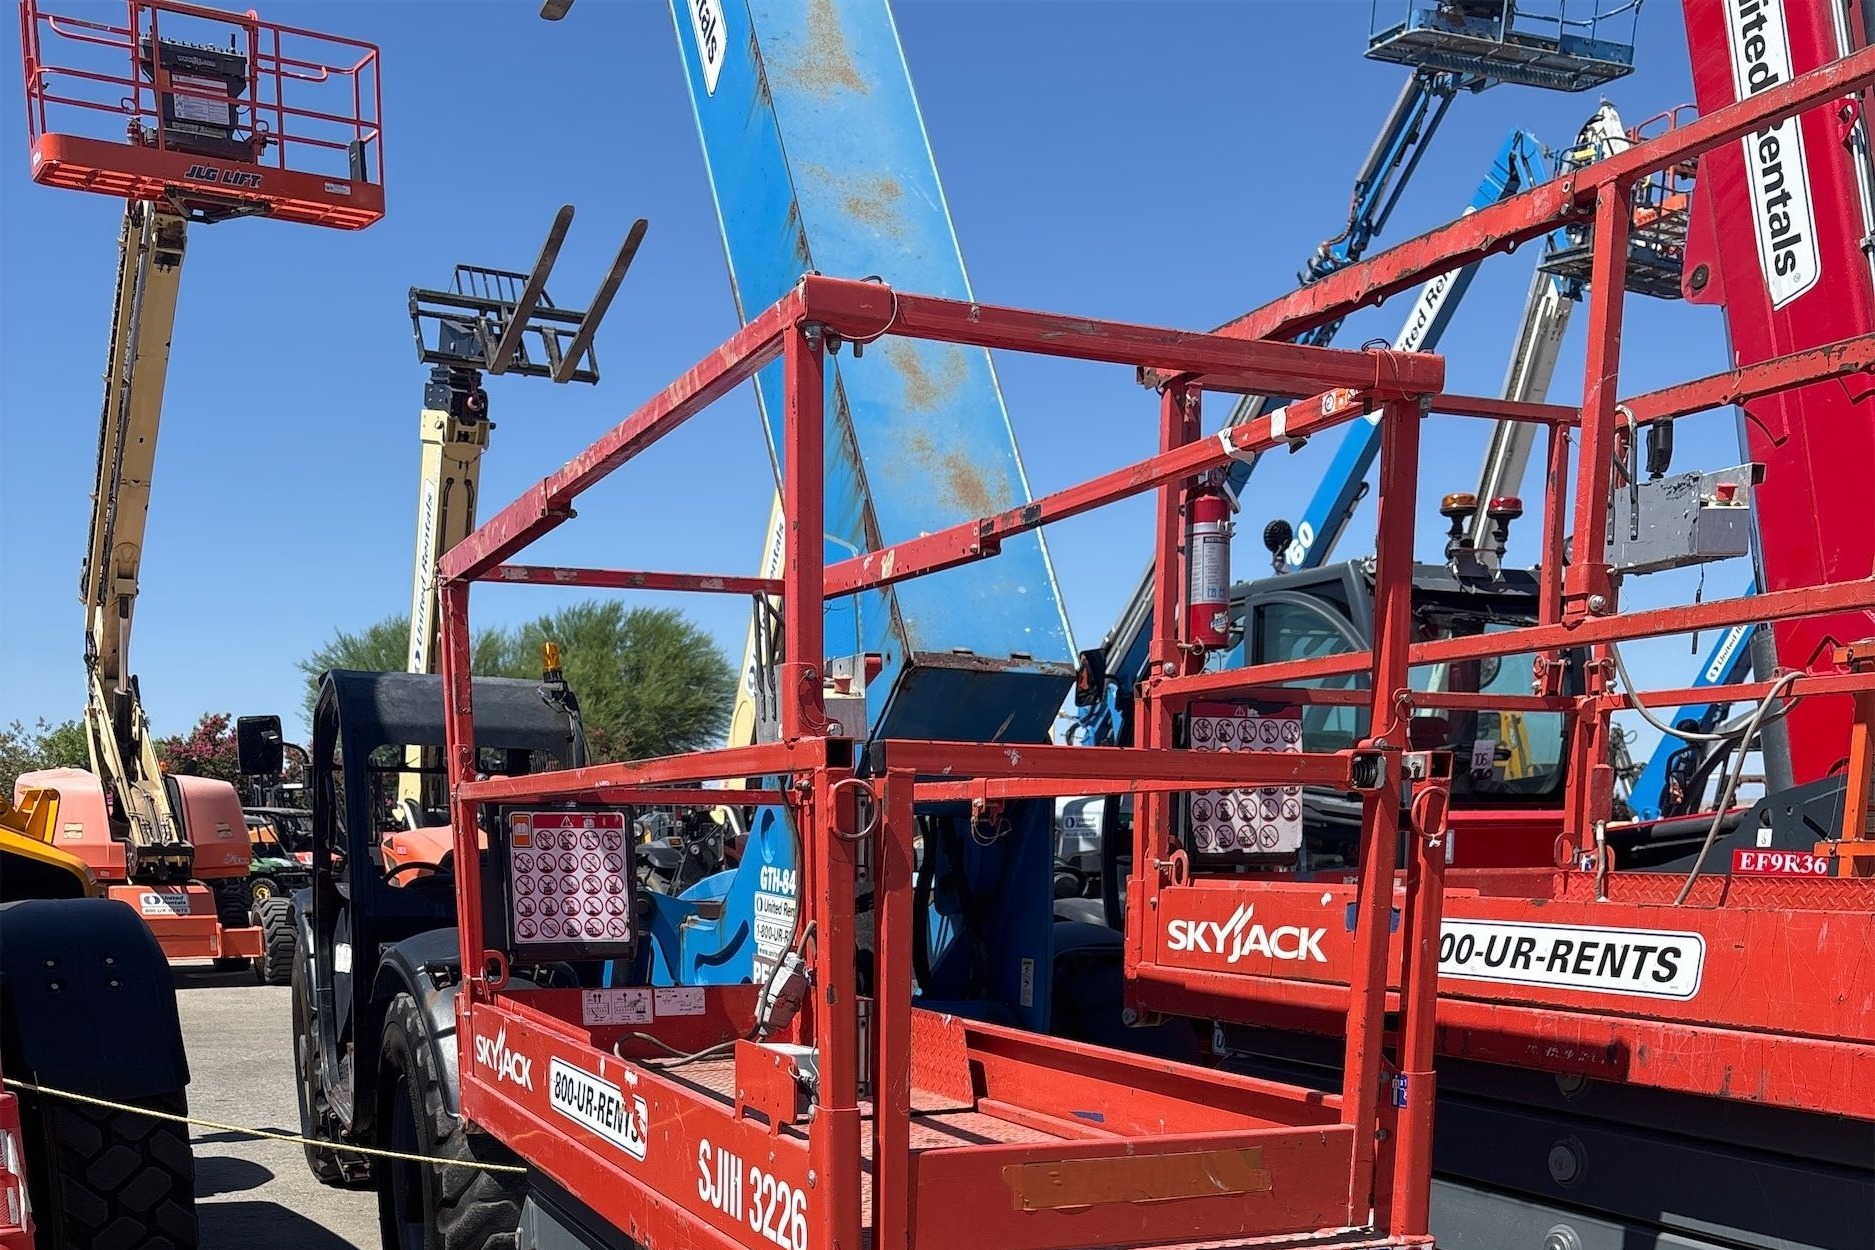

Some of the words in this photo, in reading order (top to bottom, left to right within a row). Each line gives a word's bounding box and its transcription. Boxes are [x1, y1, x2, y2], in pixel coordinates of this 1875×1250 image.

[1739, 0, 1780, 94] ited
[184, 165, 219, 182] JLG
[221, 168, 263, 188] LIFT
[421, 493, 433, 573] Rentals
[416, 580, 428, 646] United
[760, 865, 797, 895] GTH-84
[1739, 852, 1827, 874] EF9R36
[764, 899, 783, 915] United
[1167, 902, 1328, 963] SKYJACK
[1440, 932, 1682, 983] 00-UR-RENTS
[476, 1025, 534, 1092] SKYJACK
